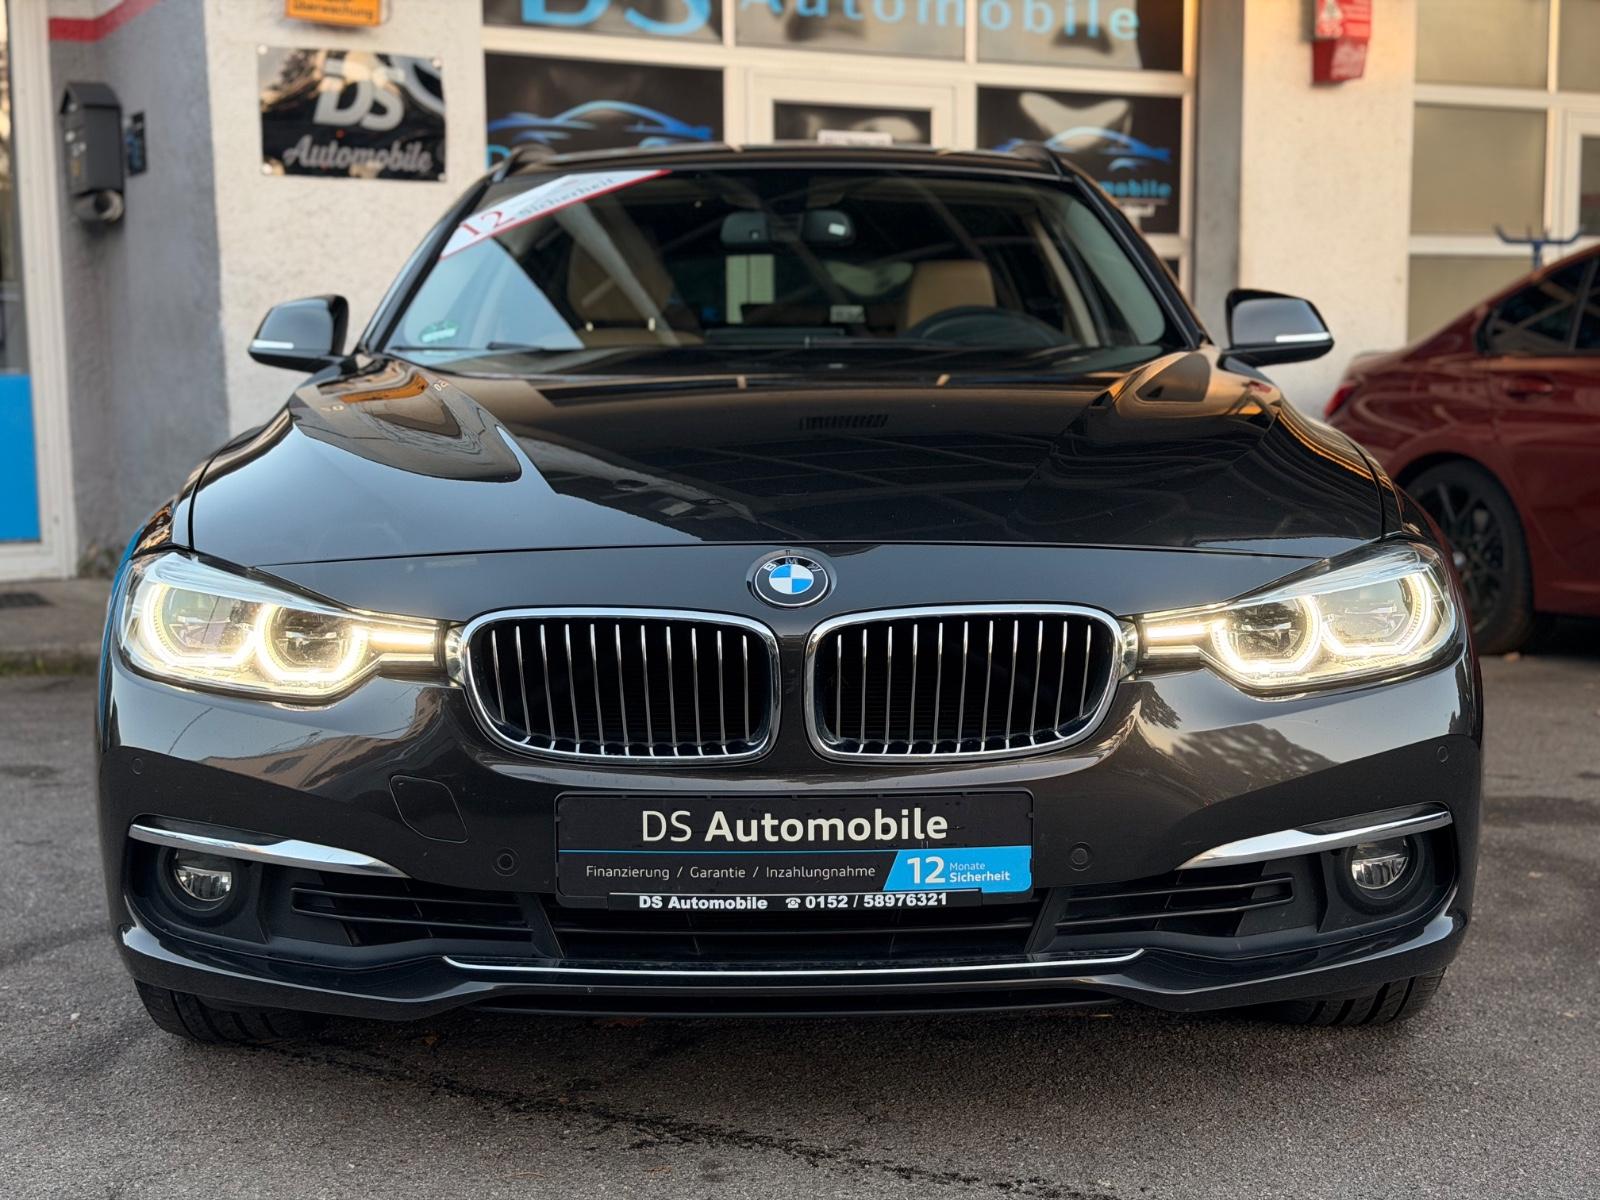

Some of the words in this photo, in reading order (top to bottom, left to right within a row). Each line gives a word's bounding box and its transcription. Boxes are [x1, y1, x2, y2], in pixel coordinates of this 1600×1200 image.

[312, 57, 405, 131] DS
[283, 134, 434, 174] Automobile
[763, 556, 822, 573] BMW
[642, 810, 693, 842] DS
[704, 807, 948, 844] Automobile
[586, 865, 670, 881] Finanzierung
[690, 866, 746, 879] Garantie
[766, 865, 876, 880] Inzahlungnahme
[907, 856, 946, 884] 12
[950, 861, 986, 871] Monate
[950, 870, 1010, 883] Sicherheit
[638, 895, 663, 909] DS
[668, 895, 768, 910] Automobile
[805, 895, 849, 910] 0152
[863, 892, 948, 909] 58976321
